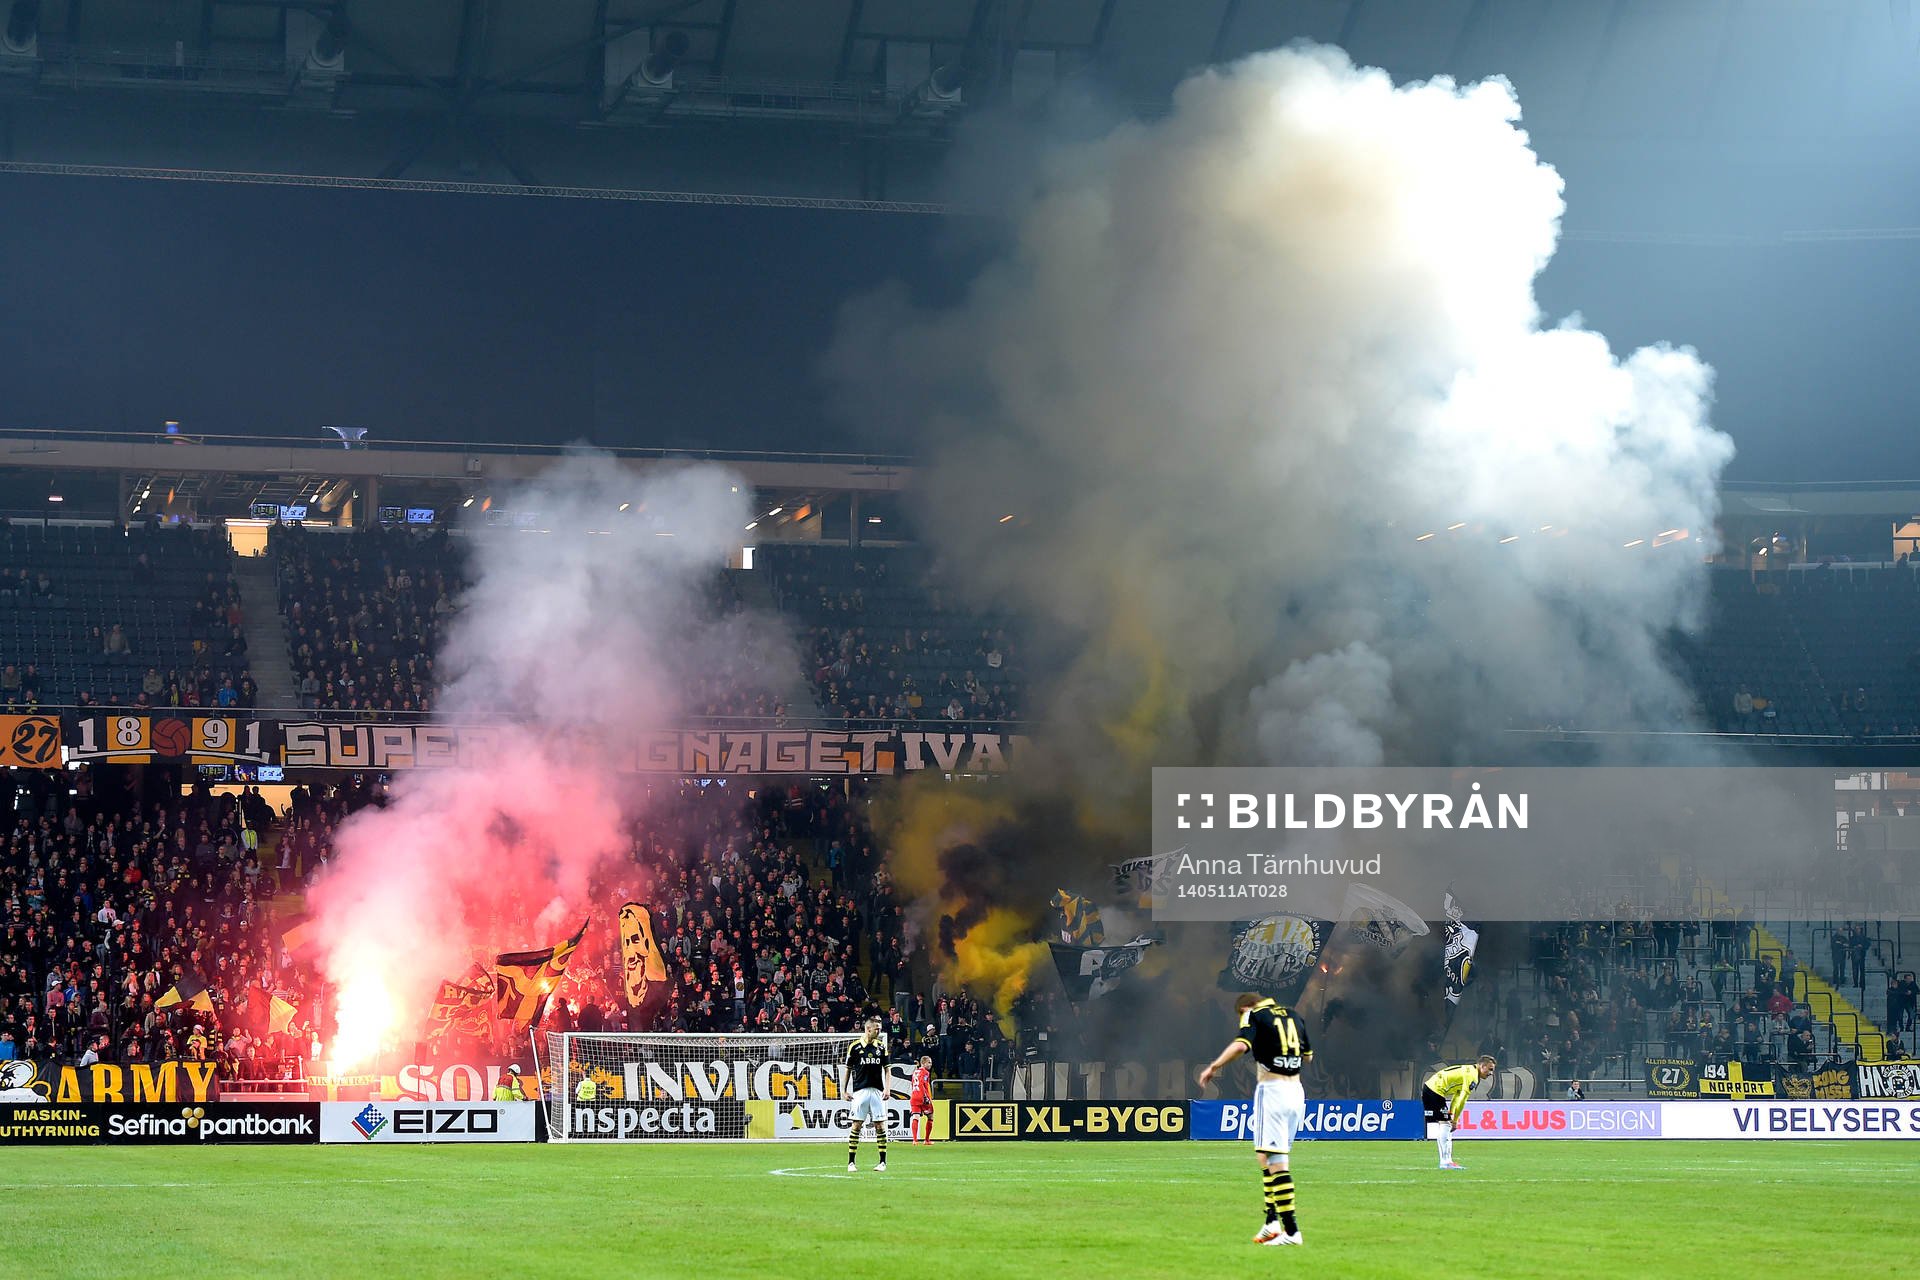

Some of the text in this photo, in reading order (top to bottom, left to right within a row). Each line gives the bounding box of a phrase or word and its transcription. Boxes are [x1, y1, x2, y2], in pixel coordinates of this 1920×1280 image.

[16, 723, 58, 764] 27
[1274, 1017, 1301, 1057] 14
[56, 1061, 217, 1103] ARMY
[1661, 1067, 1681, 1084] 27
[1709, 1081, 1764, 1094] NORRORT
[13, 1109, 87, 1122] MASKIN-
[108, 1113, 313, 1139] Sefina pantbank
[393, 1109, 498, 1134] EIZO
[803, 1107, 914, 1129] weer
[960, 1107, 1013, 1132] XL
[1025, 1106, 1185, 1133] XL-BYGG
[1480, 1109, 1499, 1131] &
[1501, 1109, 1567, 1131] LJUS
[1569, 1109, 1657, 1131] DESIGN
[1733, 1107, 1760, 1132] VI
[1769, 1107, 1901, 1133] BELYSER
[0, 1125, 100, 1138] UTHYRNING
